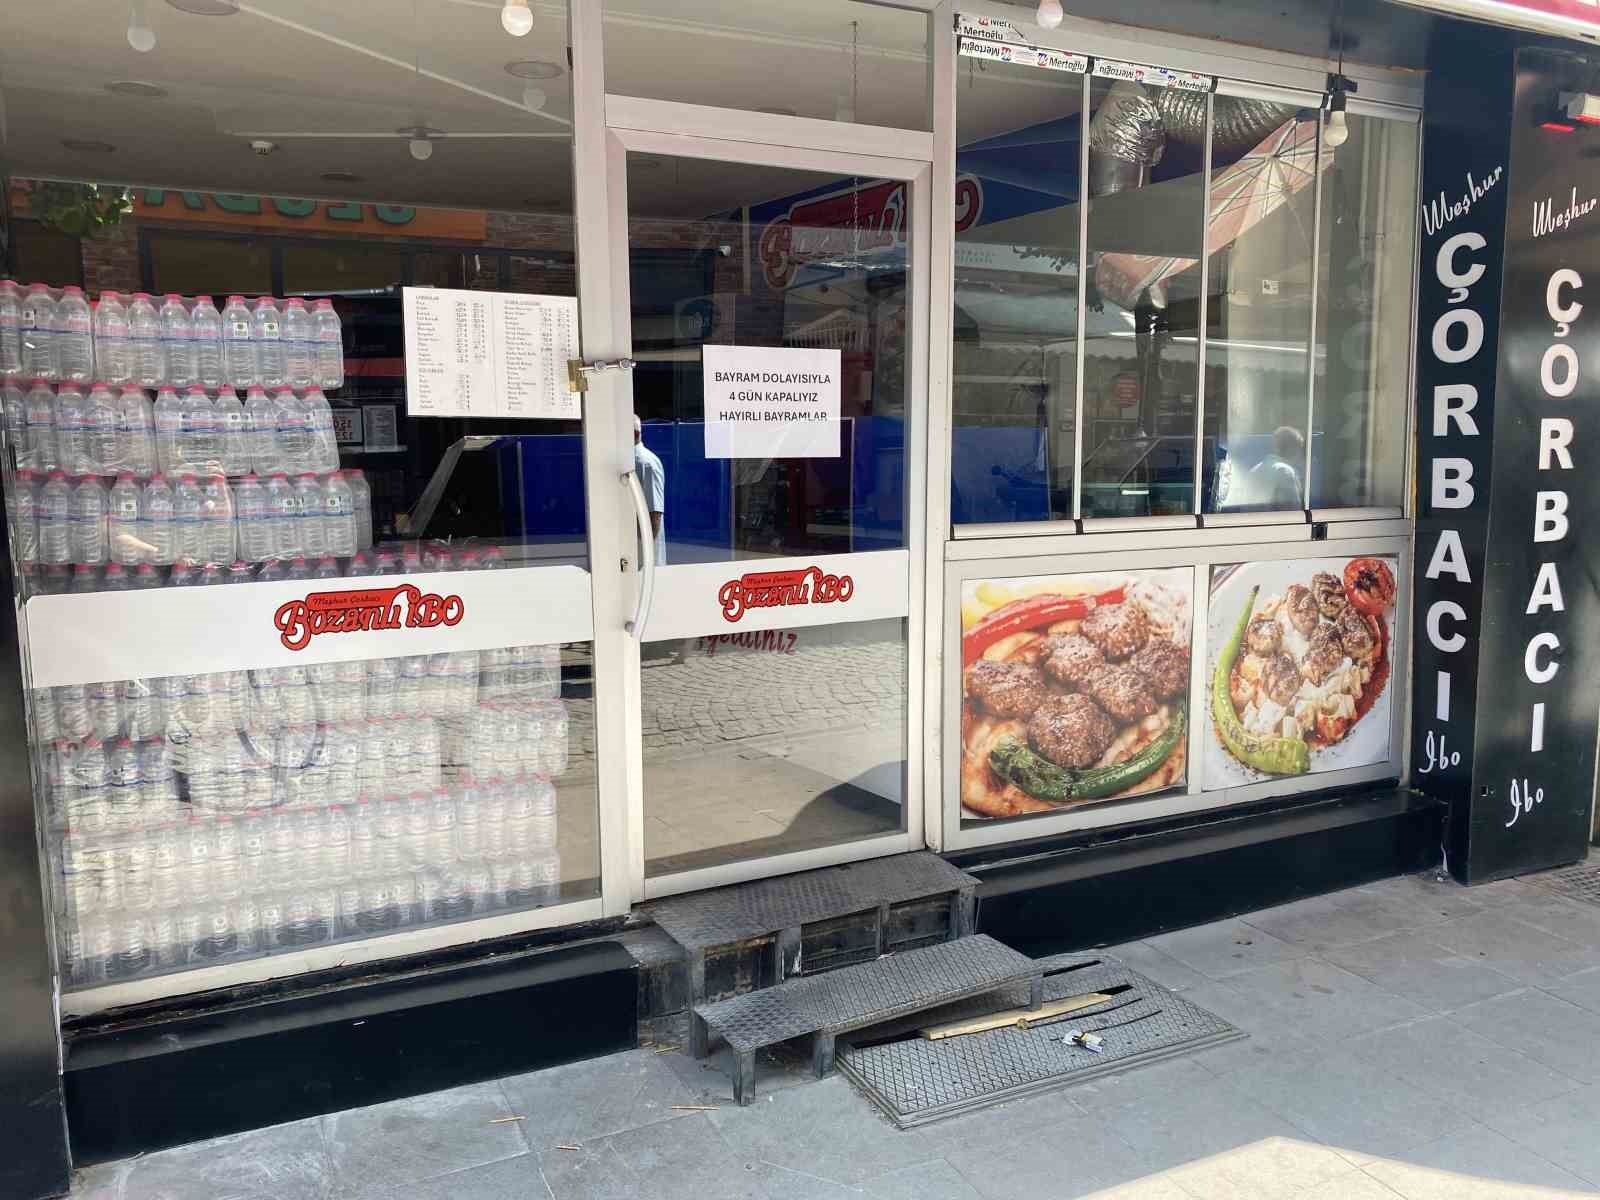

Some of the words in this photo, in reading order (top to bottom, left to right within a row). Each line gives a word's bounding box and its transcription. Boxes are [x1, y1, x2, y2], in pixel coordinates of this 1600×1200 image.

[1048, 57, 1085, 72] Mertoğlu
[1423, 166, 1503, 236] Meşhur
[1532, 187, 1597, 237] Meşhur
[715, 371, 760, 383] BAYRAM
[762, 373, 831, 384] DOLAYISIYLA
[729, 391, 736, 401] 4
[738, 389, 762, 401] GÜN
[765, 392, 819, 402] KAPALIYIZ
[719, 410, 761, 421] HAYIRLI
[764, 411, 828, 422] BAYRAMLAR
[1425, 231, 1488, 722] ÇORBACI
[1524, 268, 1584, 752] ÇORBACI
